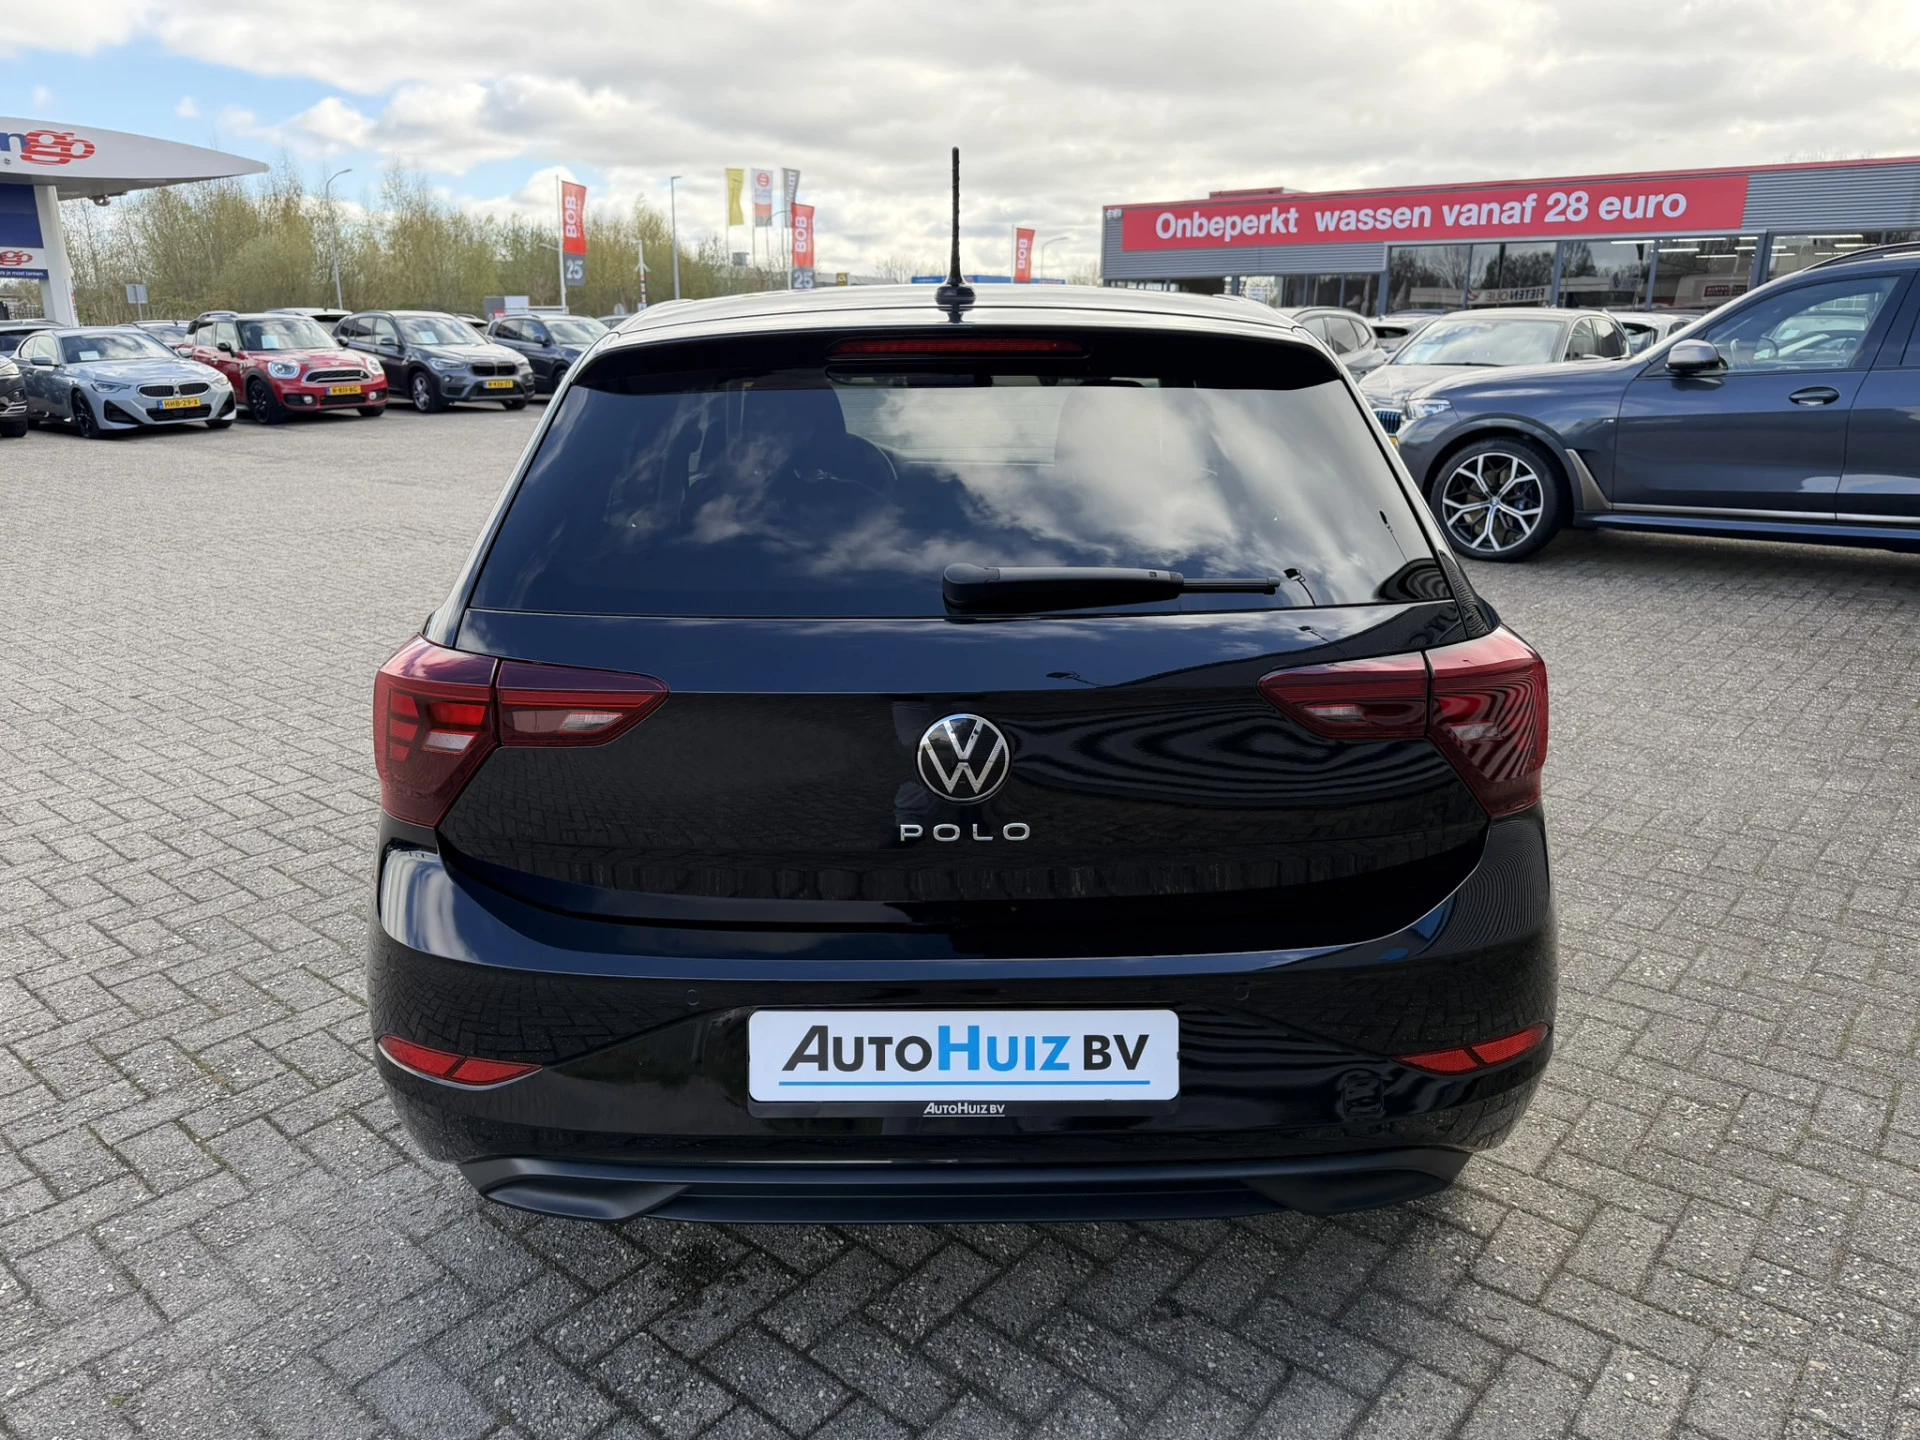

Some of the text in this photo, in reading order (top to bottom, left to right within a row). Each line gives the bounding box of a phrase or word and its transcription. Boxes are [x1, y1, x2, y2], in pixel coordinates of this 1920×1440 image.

[564, 195, 578, 239] BOB
[1155, 190, 1688, 242] Onbeperkt wassen vanaf 28 euro
[795, 216, 808, 253] BOB
[566, 259, 583, 280] 25
[793, 271, 814, 288] 25
[899, 822, 1031, 842] POLO
[1082, 1034, 1150, 1071] BV
[989, 1104, 1006, 1115] BV
